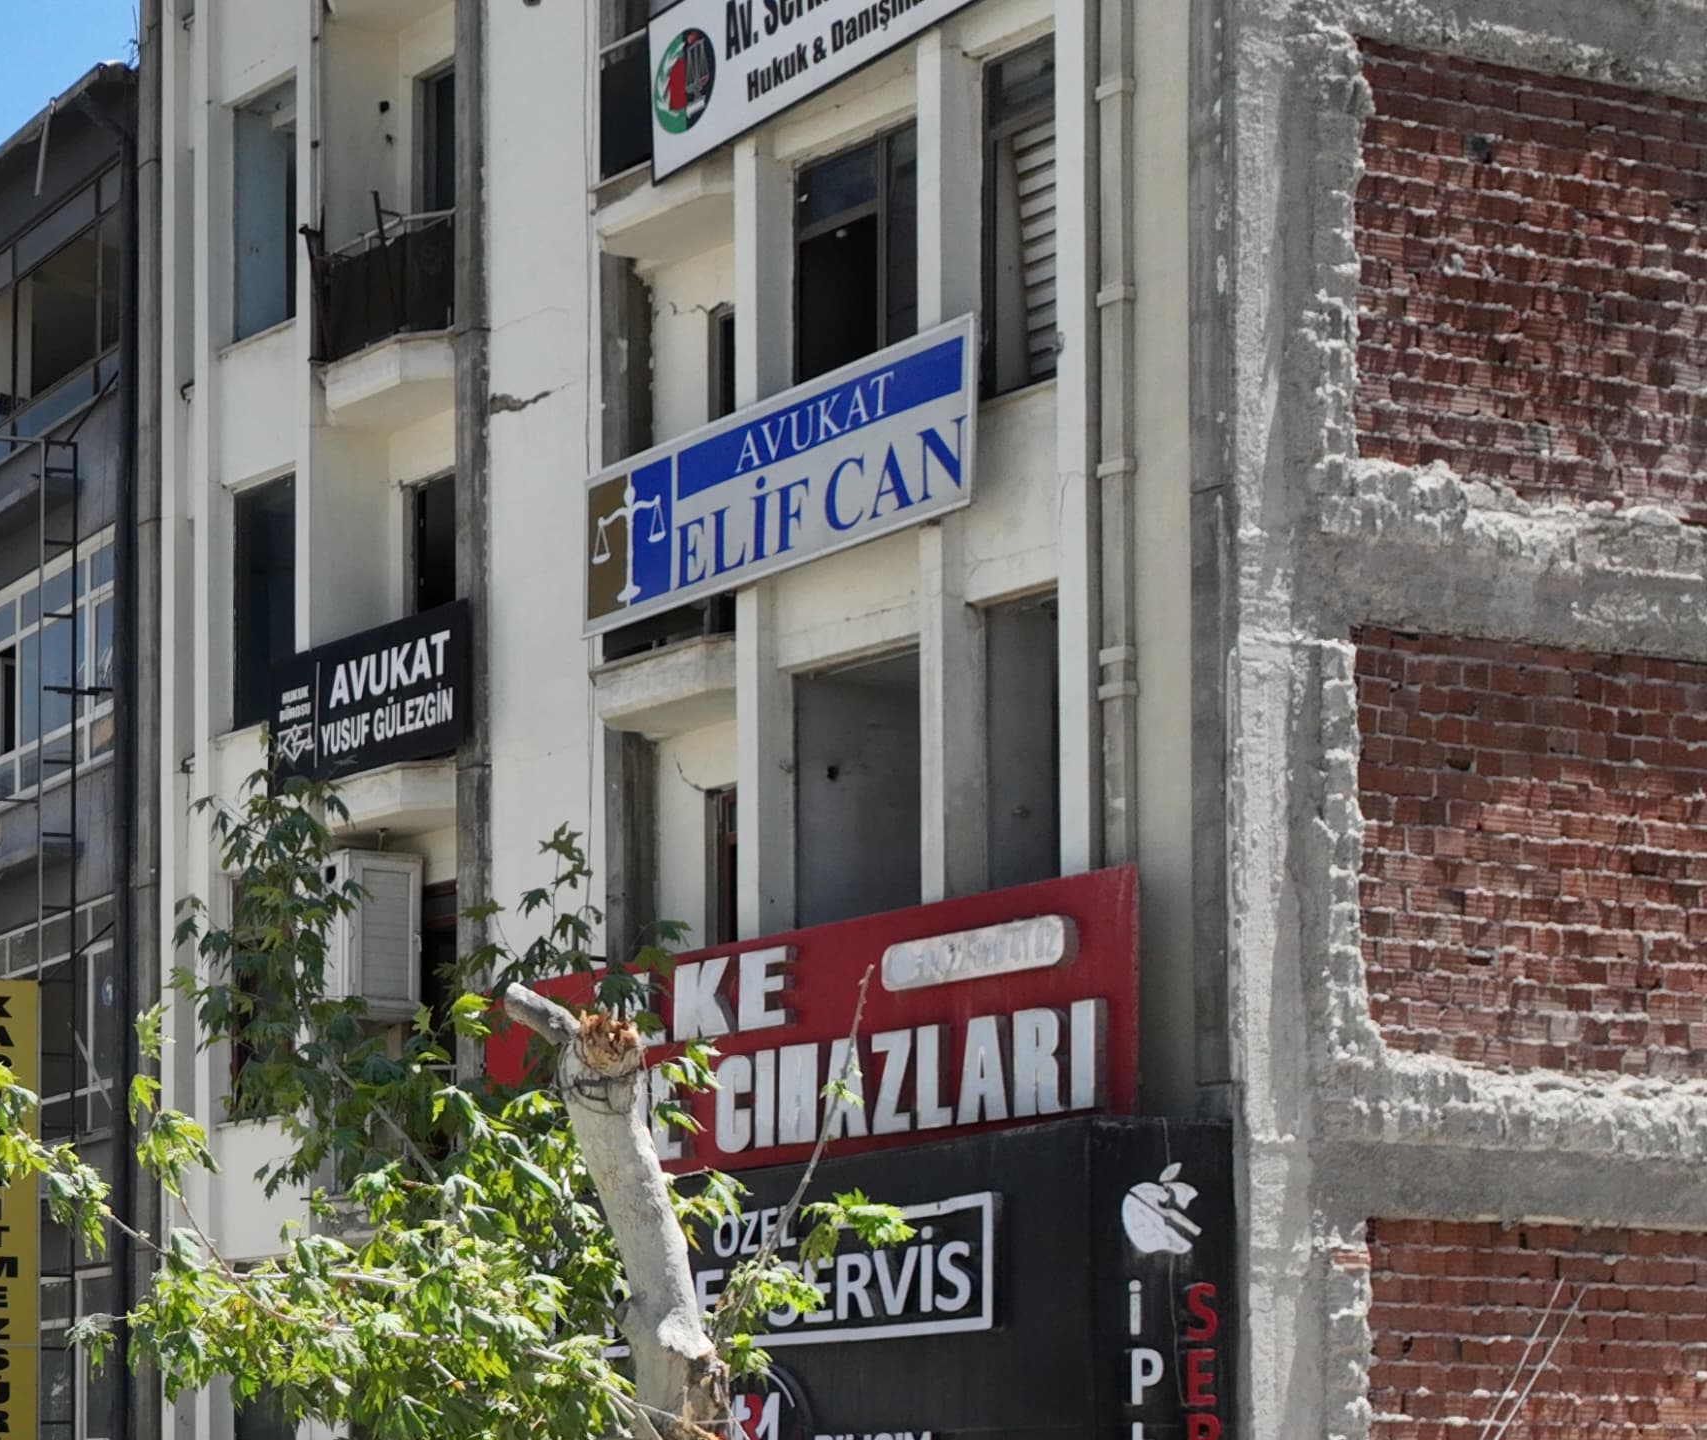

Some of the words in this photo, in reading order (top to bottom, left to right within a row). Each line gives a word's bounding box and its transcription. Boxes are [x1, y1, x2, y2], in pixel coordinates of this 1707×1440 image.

[747, 42, 807, 102] Hukuk
[813, 36, 827, 63] &
[735, 371, 894, 474] AVUKAT
[674, 475, 810, 591] ELİF
[825, 414, 969, 531] CAN
[329, 629, 452, 709] AVUKAT
[321, 711, 371, 757] YUSUF
[373, 682, 454, 742] GÜLEZGİN
